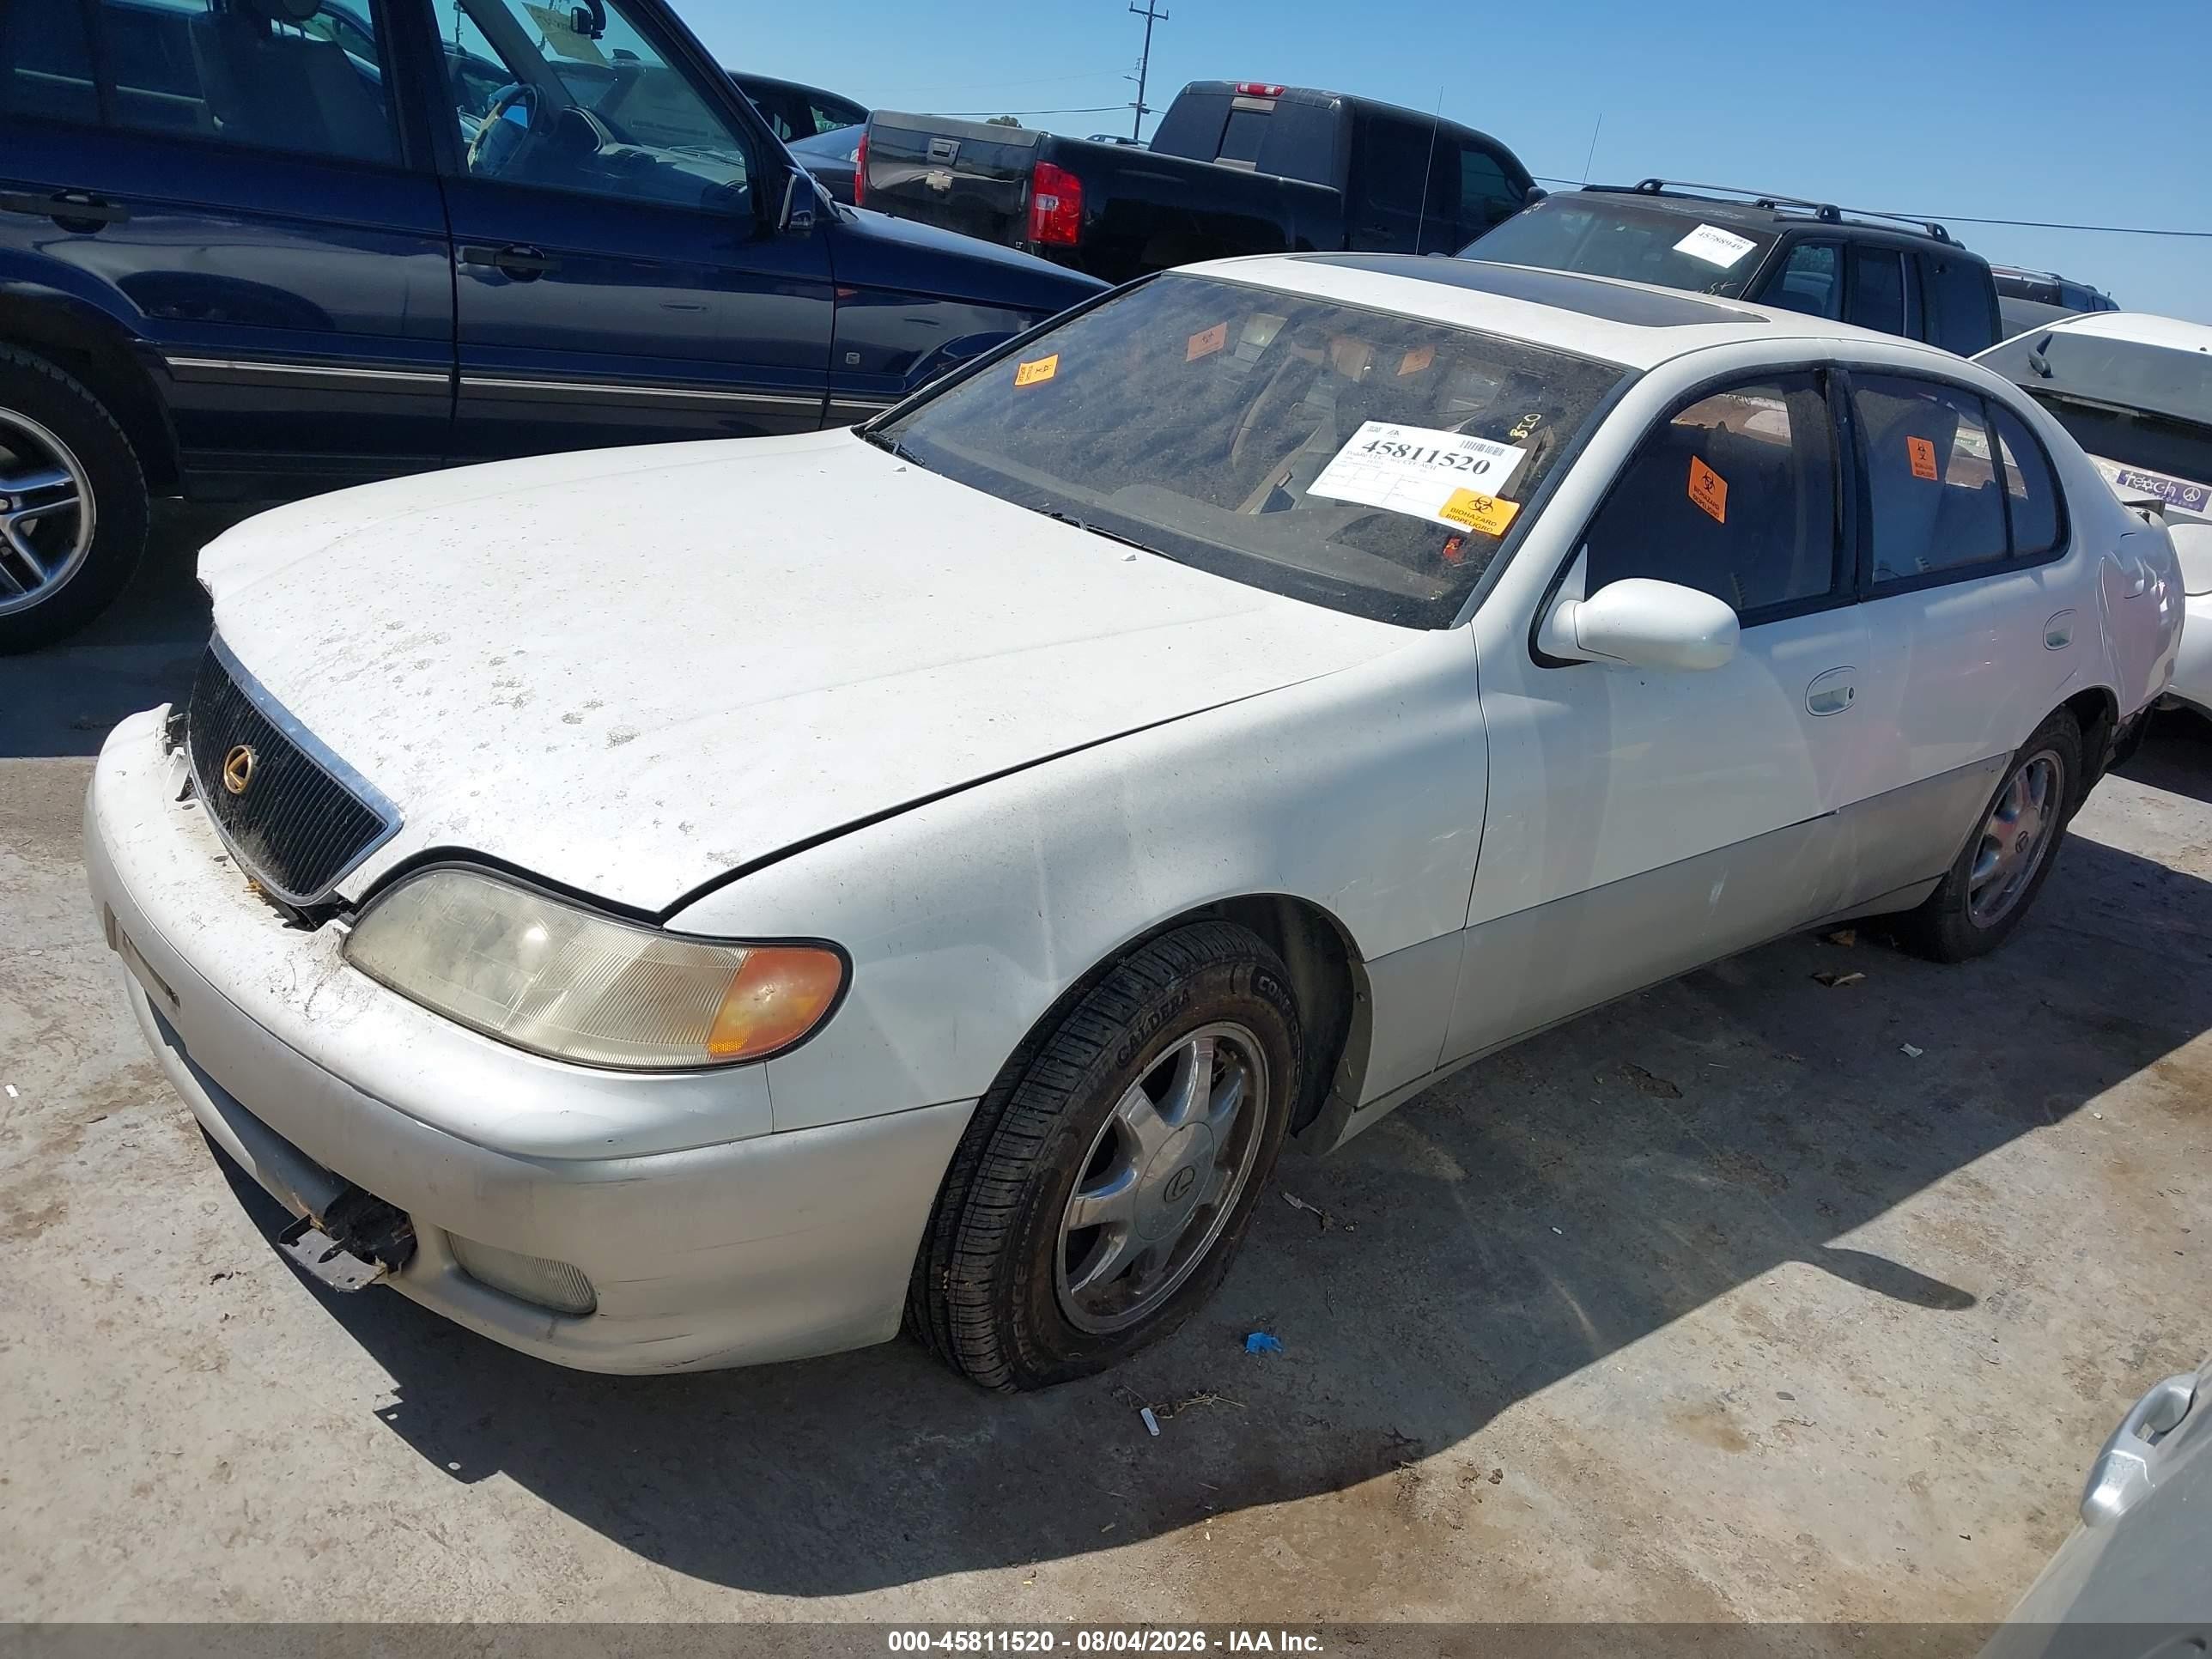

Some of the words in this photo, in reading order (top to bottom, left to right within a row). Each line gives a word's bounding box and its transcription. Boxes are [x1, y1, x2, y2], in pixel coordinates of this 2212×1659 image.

[1510, 413, 1542, 439] BIO
[1361, 438, 1492, 475] 45811520
[1446, 514, 1493, 532] BIOPELIGRO
[1450, 507, 1498, 527] BIOHAZARD
